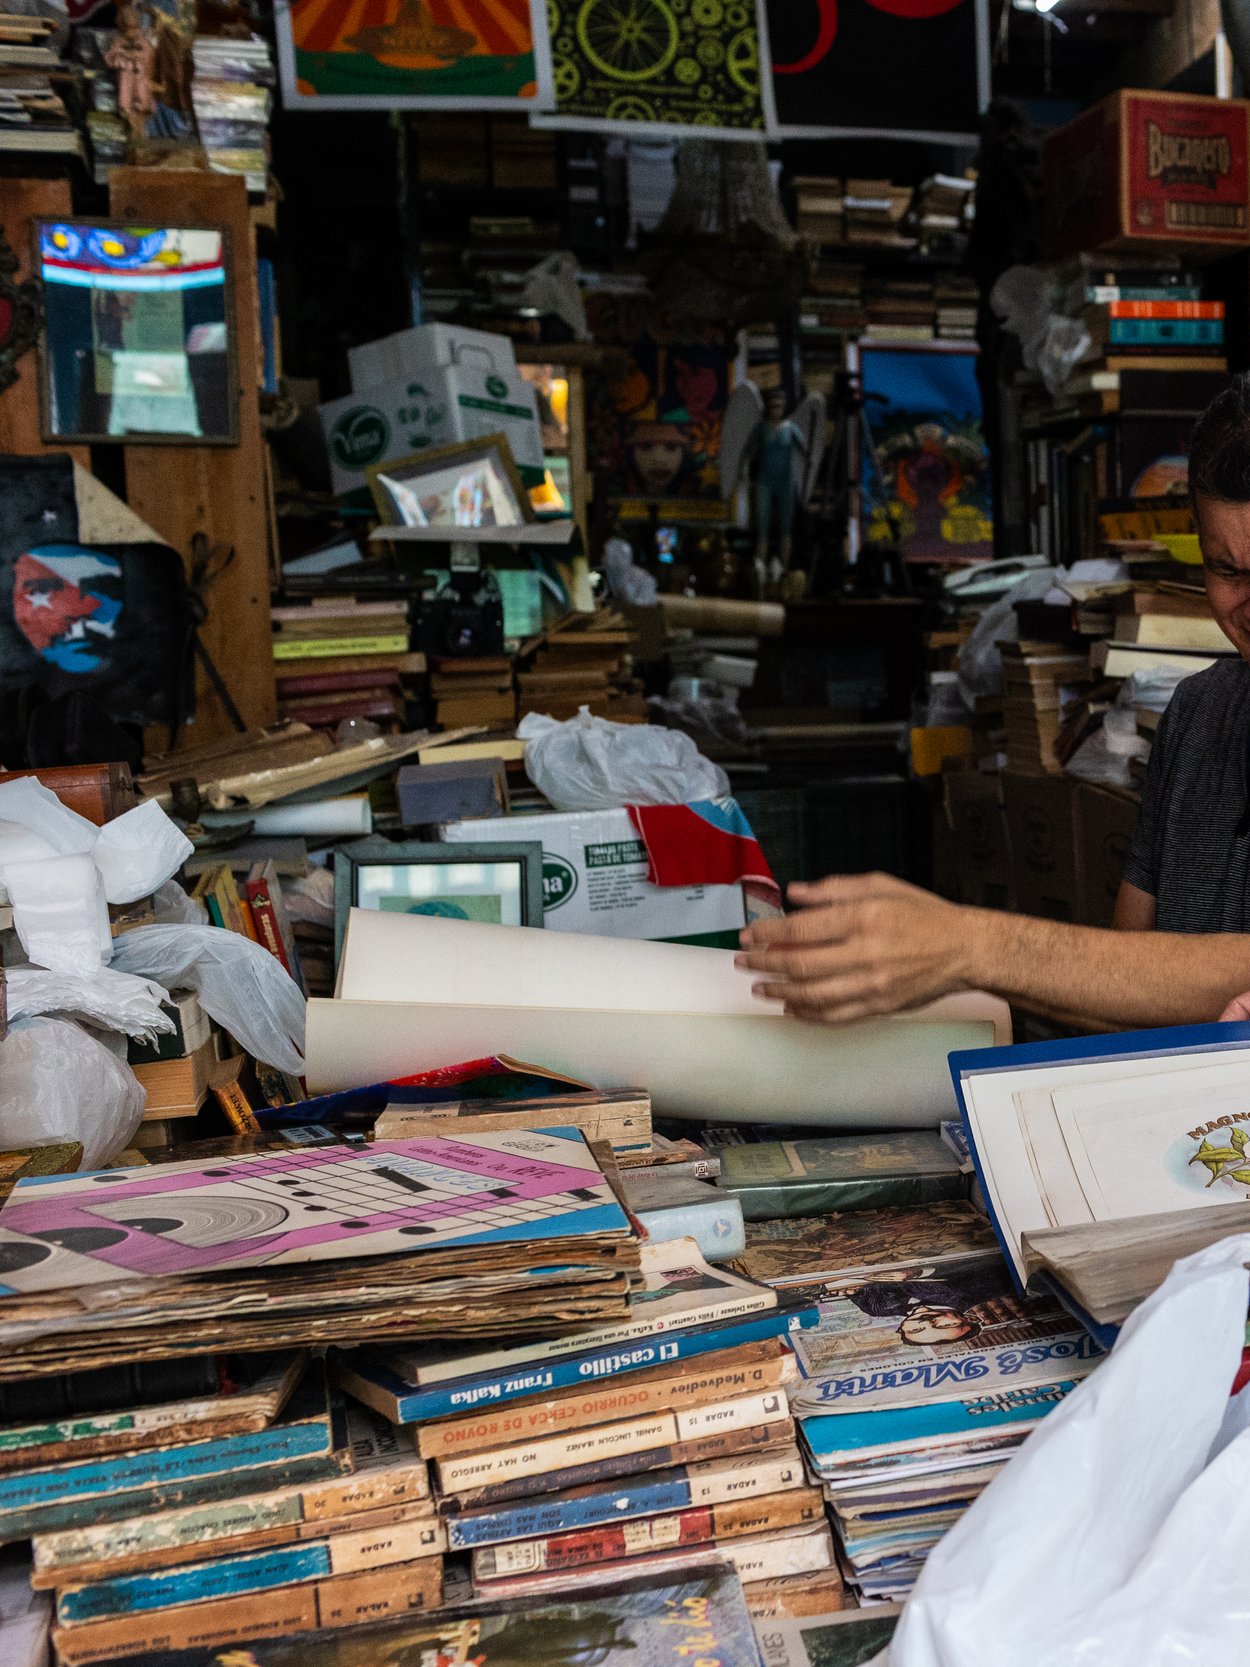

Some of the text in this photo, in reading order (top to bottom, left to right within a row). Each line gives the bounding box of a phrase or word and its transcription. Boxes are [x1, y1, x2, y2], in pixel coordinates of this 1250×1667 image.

[721, 1304, 745, 1316] Deleuze
[746, 1301, 764, 1310] Gilles
[669, 1315, 696, 1327] Guattari
[1000, 1342, 1014, 1351] DE
[937, 1346, 996, 1360] POSTALES
[918, 1355, 934, 1364] EN
[816, 1333, 1108, 1402] José Martí
[859, 1359, 914, 1374] COLORES
[449, 1342, 679, 1407] El castillo Franz Kafka
[748, 1369, 763, 1380] D.
[670, 1372, 745, 1395] Medvediev
[582, 1390, 650, 1415] OCURRIO
[689, 1417, 698, 1425] 15
[705, 1410, 734, 1422] RADAR
[503, 1418, 522, 1431] DE
[443, 1423, 498, 1444] ROVNO
[598, 1431, 631, 1446] LINCOLN
[635, 1425, 662, 1440] DANIEL
[498, 1457, 518, 1469] HAY
[522, 1453, 537, 1463] NO
[450, 1463, 493, 1479] ARREGLO
[726, 1479, 756, 1491] RADAR
[360, 1538, 392, 1554] RADAR
[737, 1561, 764, 1571] RADA
